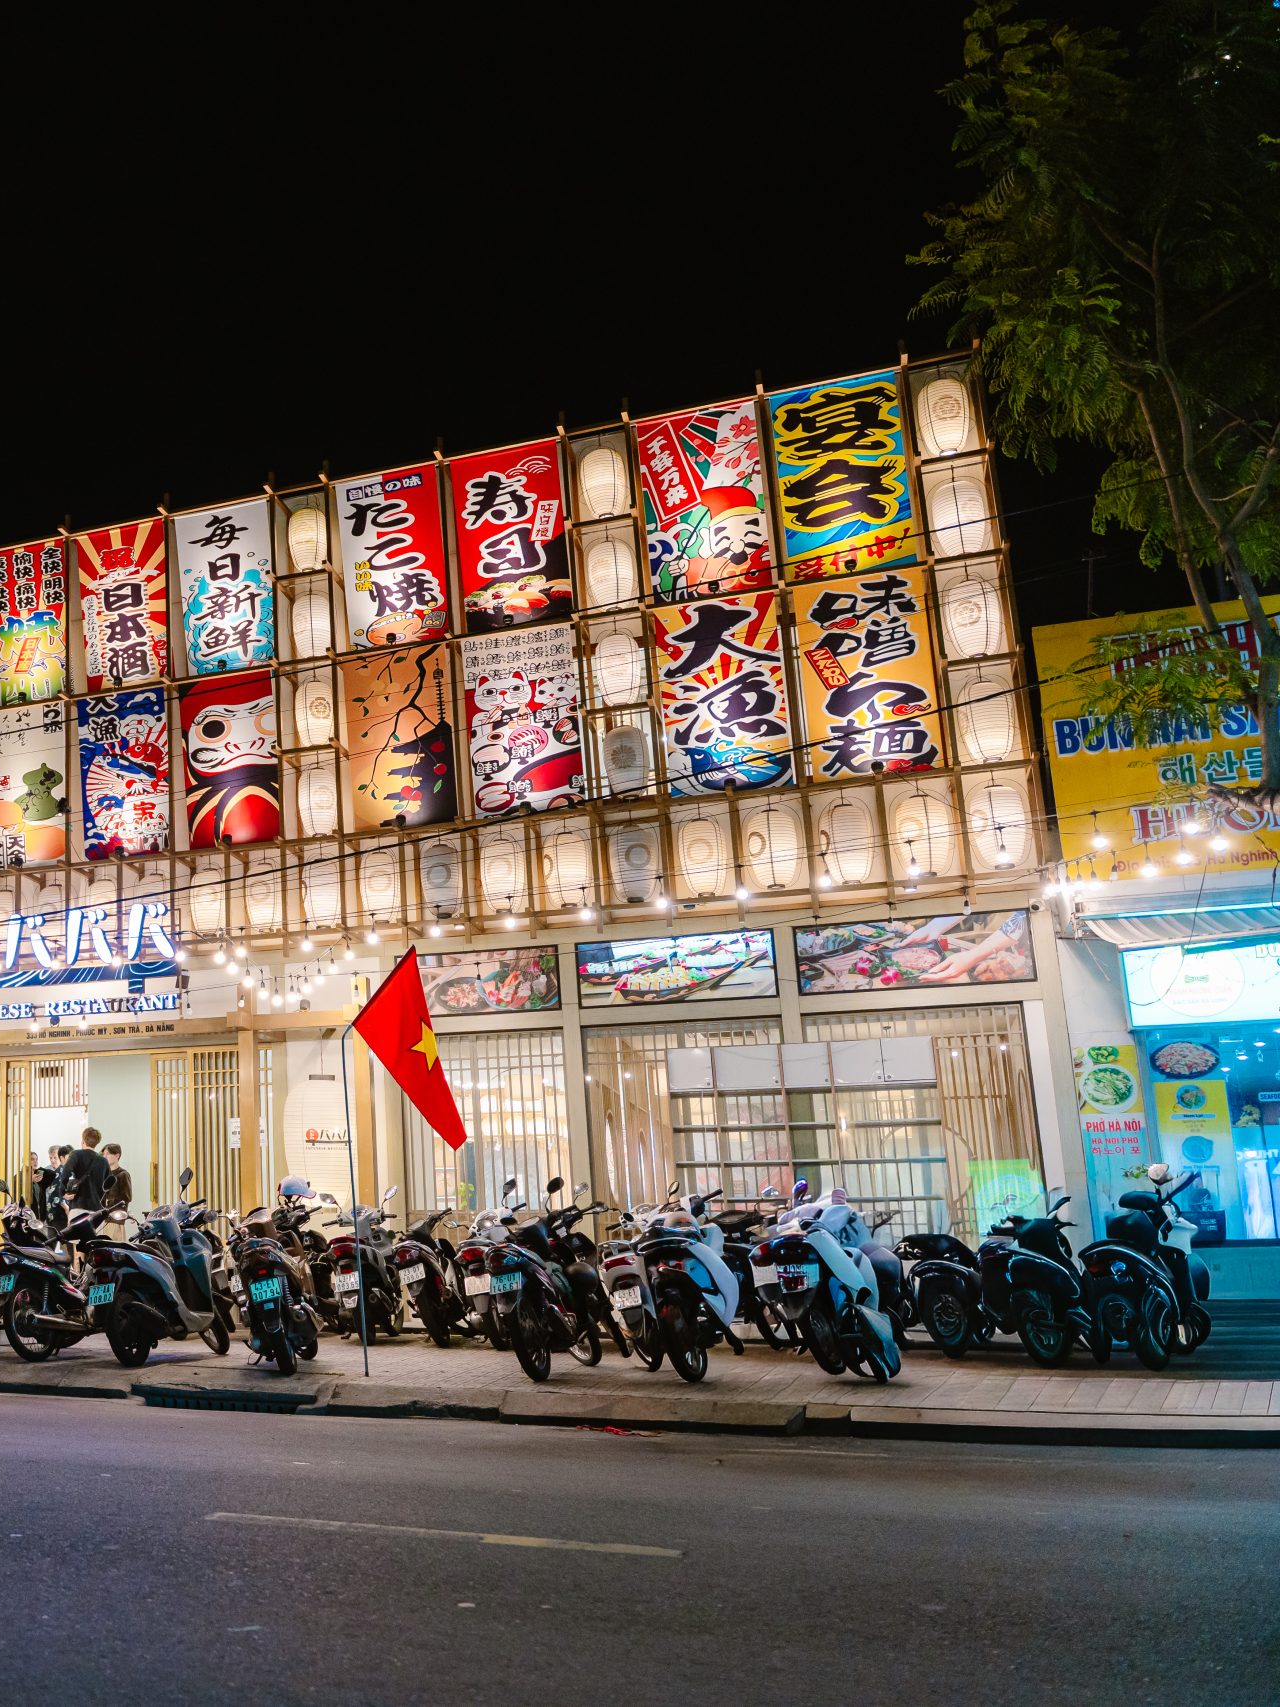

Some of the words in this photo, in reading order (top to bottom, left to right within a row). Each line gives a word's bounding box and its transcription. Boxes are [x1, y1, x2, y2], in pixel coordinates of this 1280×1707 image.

[463, 472, 547, 577] 寿司
[187, 514, 263, 659] 毎日新鮮
[102, 582, 150, 680] 日本酒
[5, 902, 176, 969] バババ
[44, 993, 179, 1017] RESTAURANT
[1085, 1118, 1106, 1133] PHỞ
[1108, 1118, 1122, 1132] HÀ
[1124, 1118, 1141, 1134] NỘI
